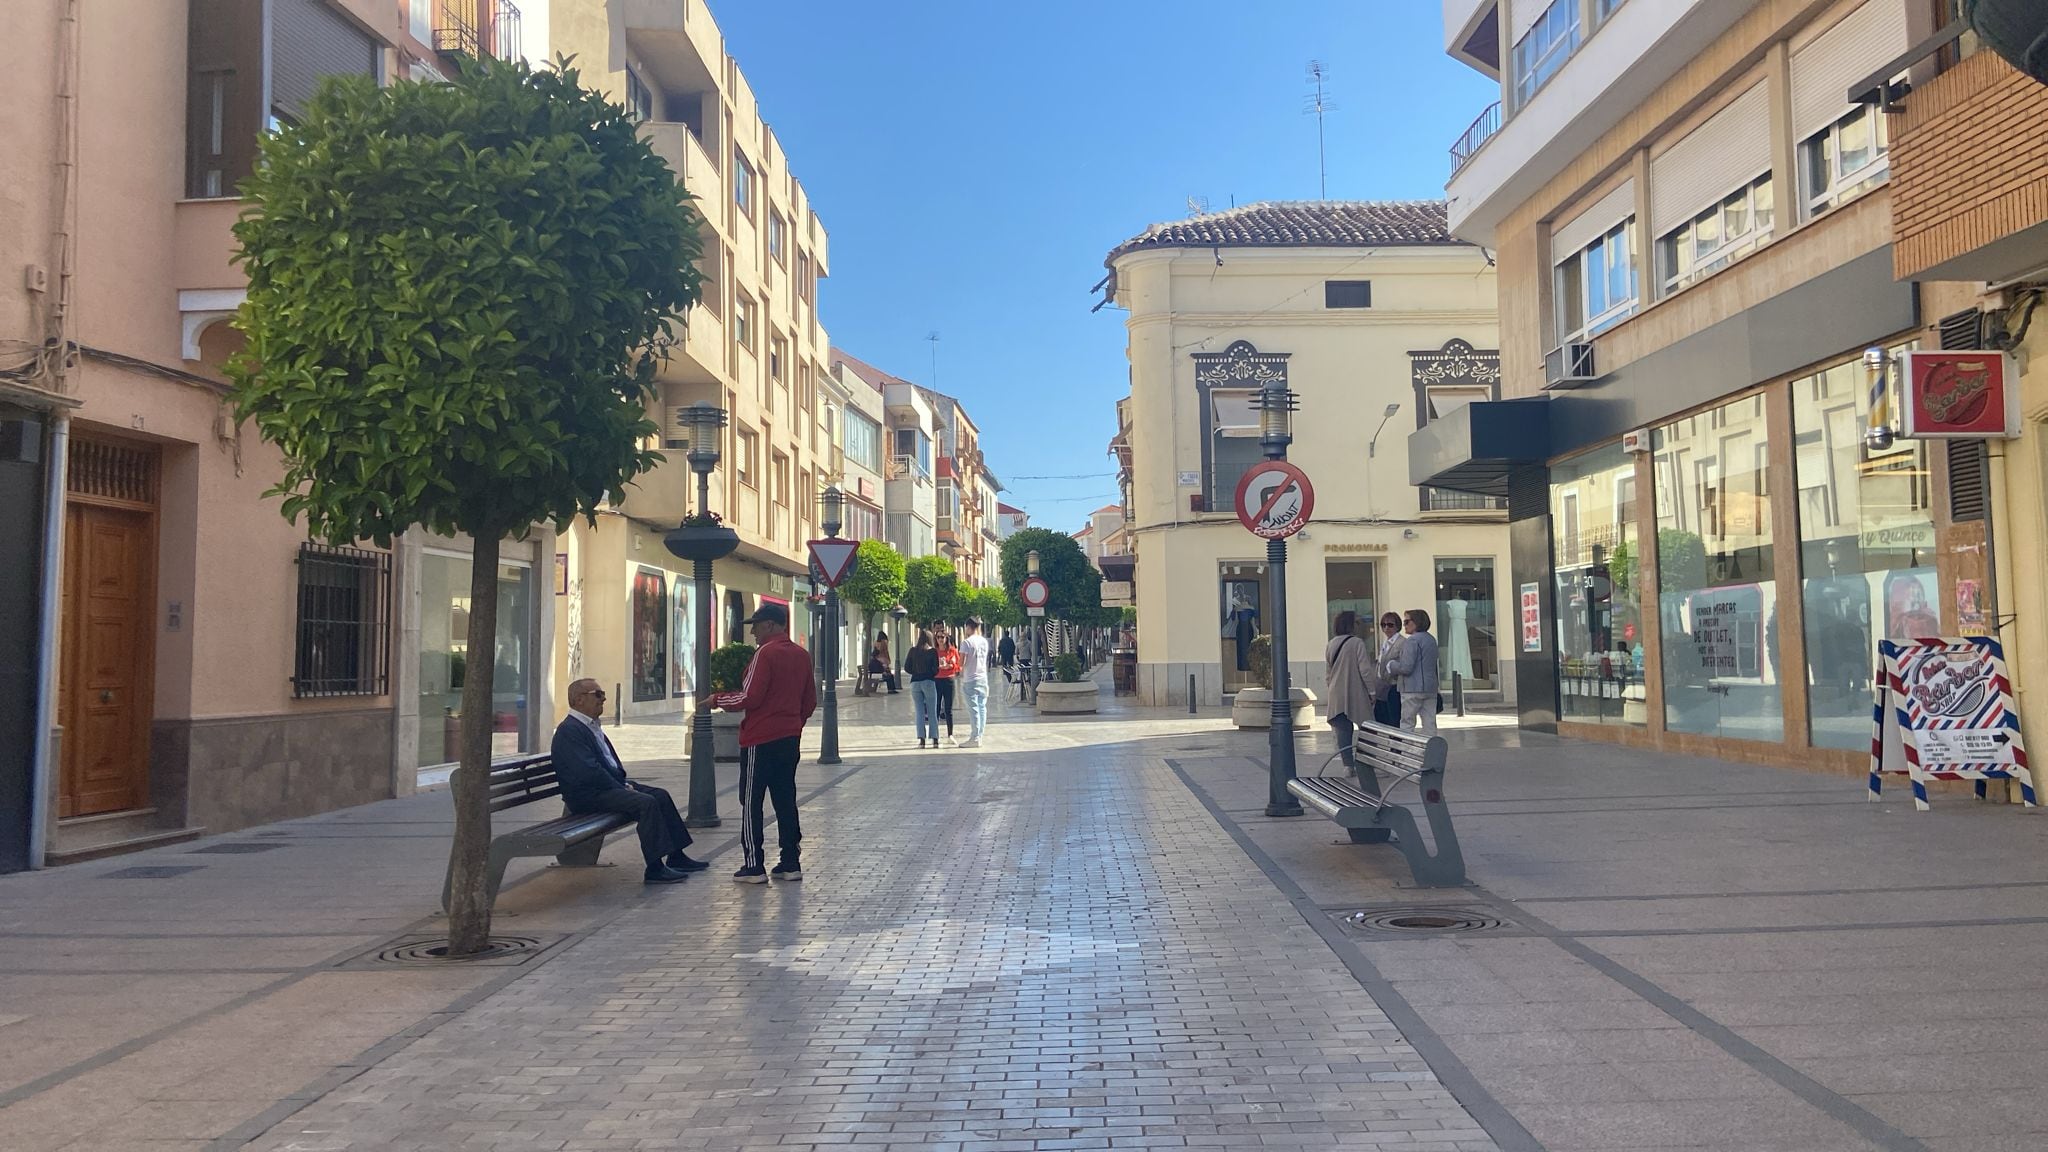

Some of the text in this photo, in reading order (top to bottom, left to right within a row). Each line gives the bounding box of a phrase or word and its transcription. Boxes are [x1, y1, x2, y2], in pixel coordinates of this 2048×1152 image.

[1879, 529, 1926, 545] Quince
[1324, 543, 1388, 553] PRONOVIAS
[1713, 602, 1737, 615] MARCAS
[1694, 630, 1701, 643] DE
[1940, 692, 1957, 709] SHOP
